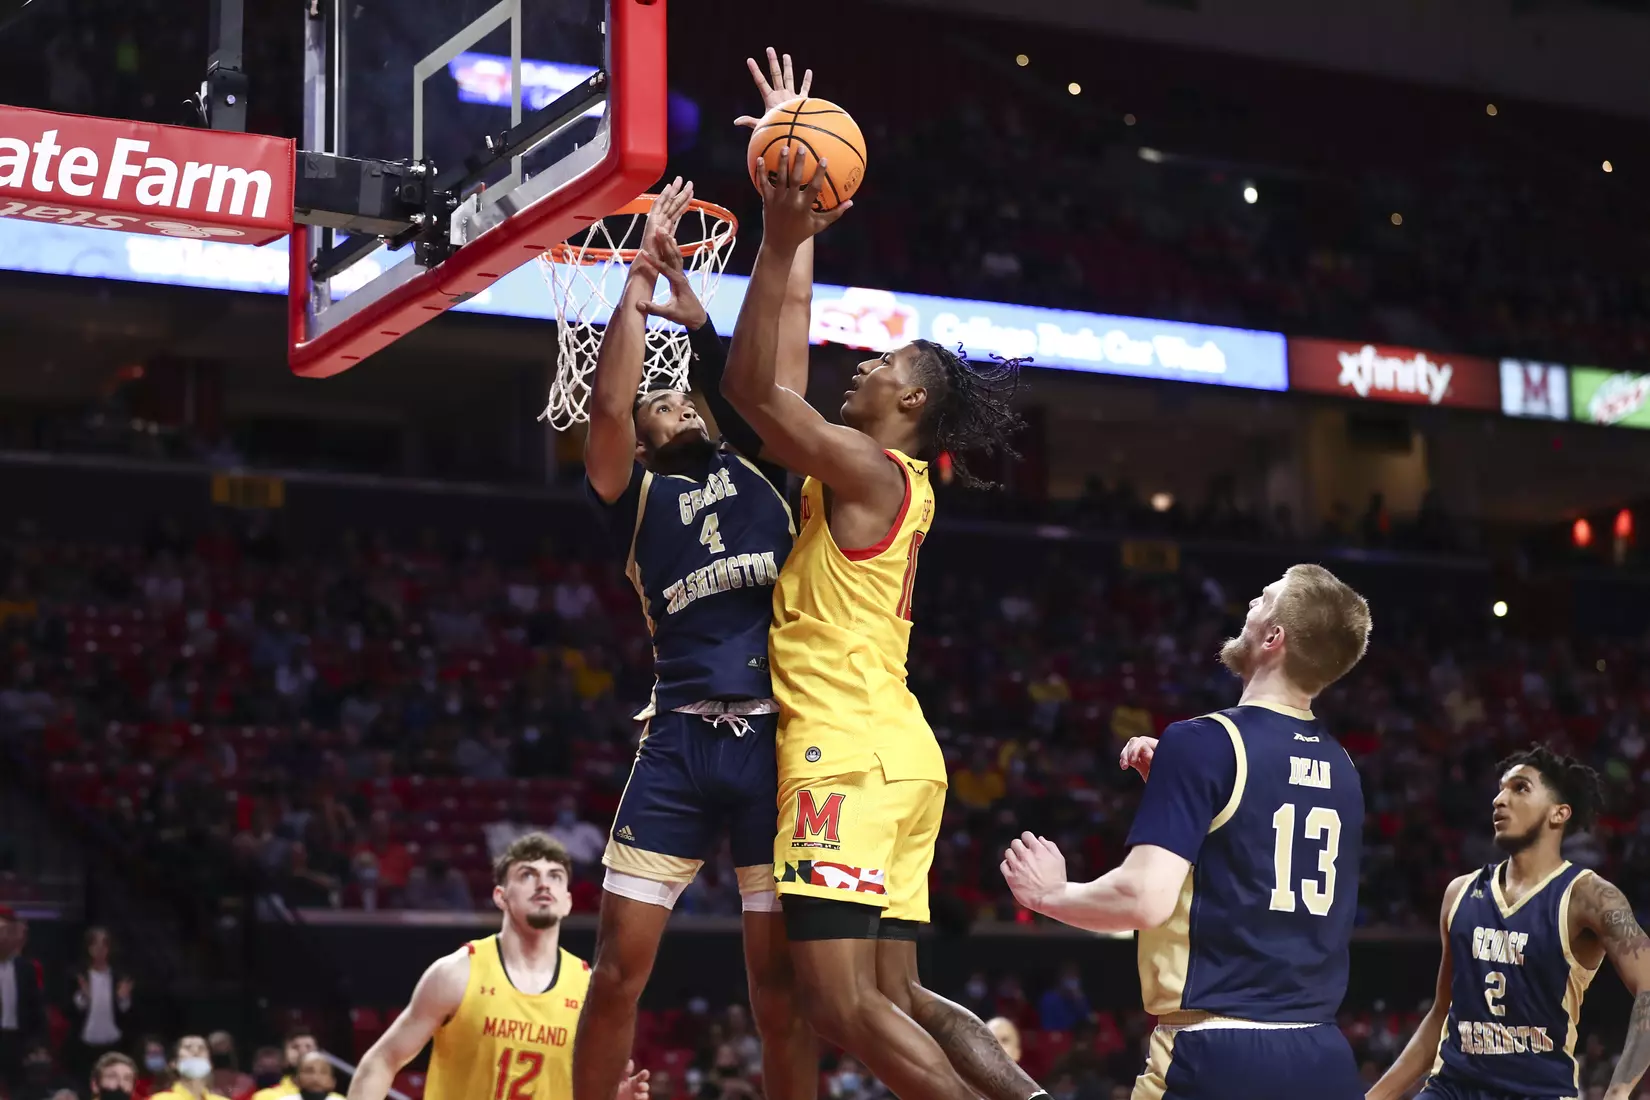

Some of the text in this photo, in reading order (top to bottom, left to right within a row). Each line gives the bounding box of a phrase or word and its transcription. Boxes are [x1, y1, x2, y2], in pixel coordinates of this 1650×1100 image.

[1338, 345, 1453, 404] xfinity
[699, 512, 726, 554] 4
[1288, 755, 1331, 789] DEAN
[792, 790, 846, 842] M
[1269, 802, 1342, 917] 13
[1472, 926, 1529, 966] GEORGE
[1484, 971, 1507, 1017] 2
[483, 1016, 568, 1047] MARYLAND
[495, 1047, 545, 1100] 12
